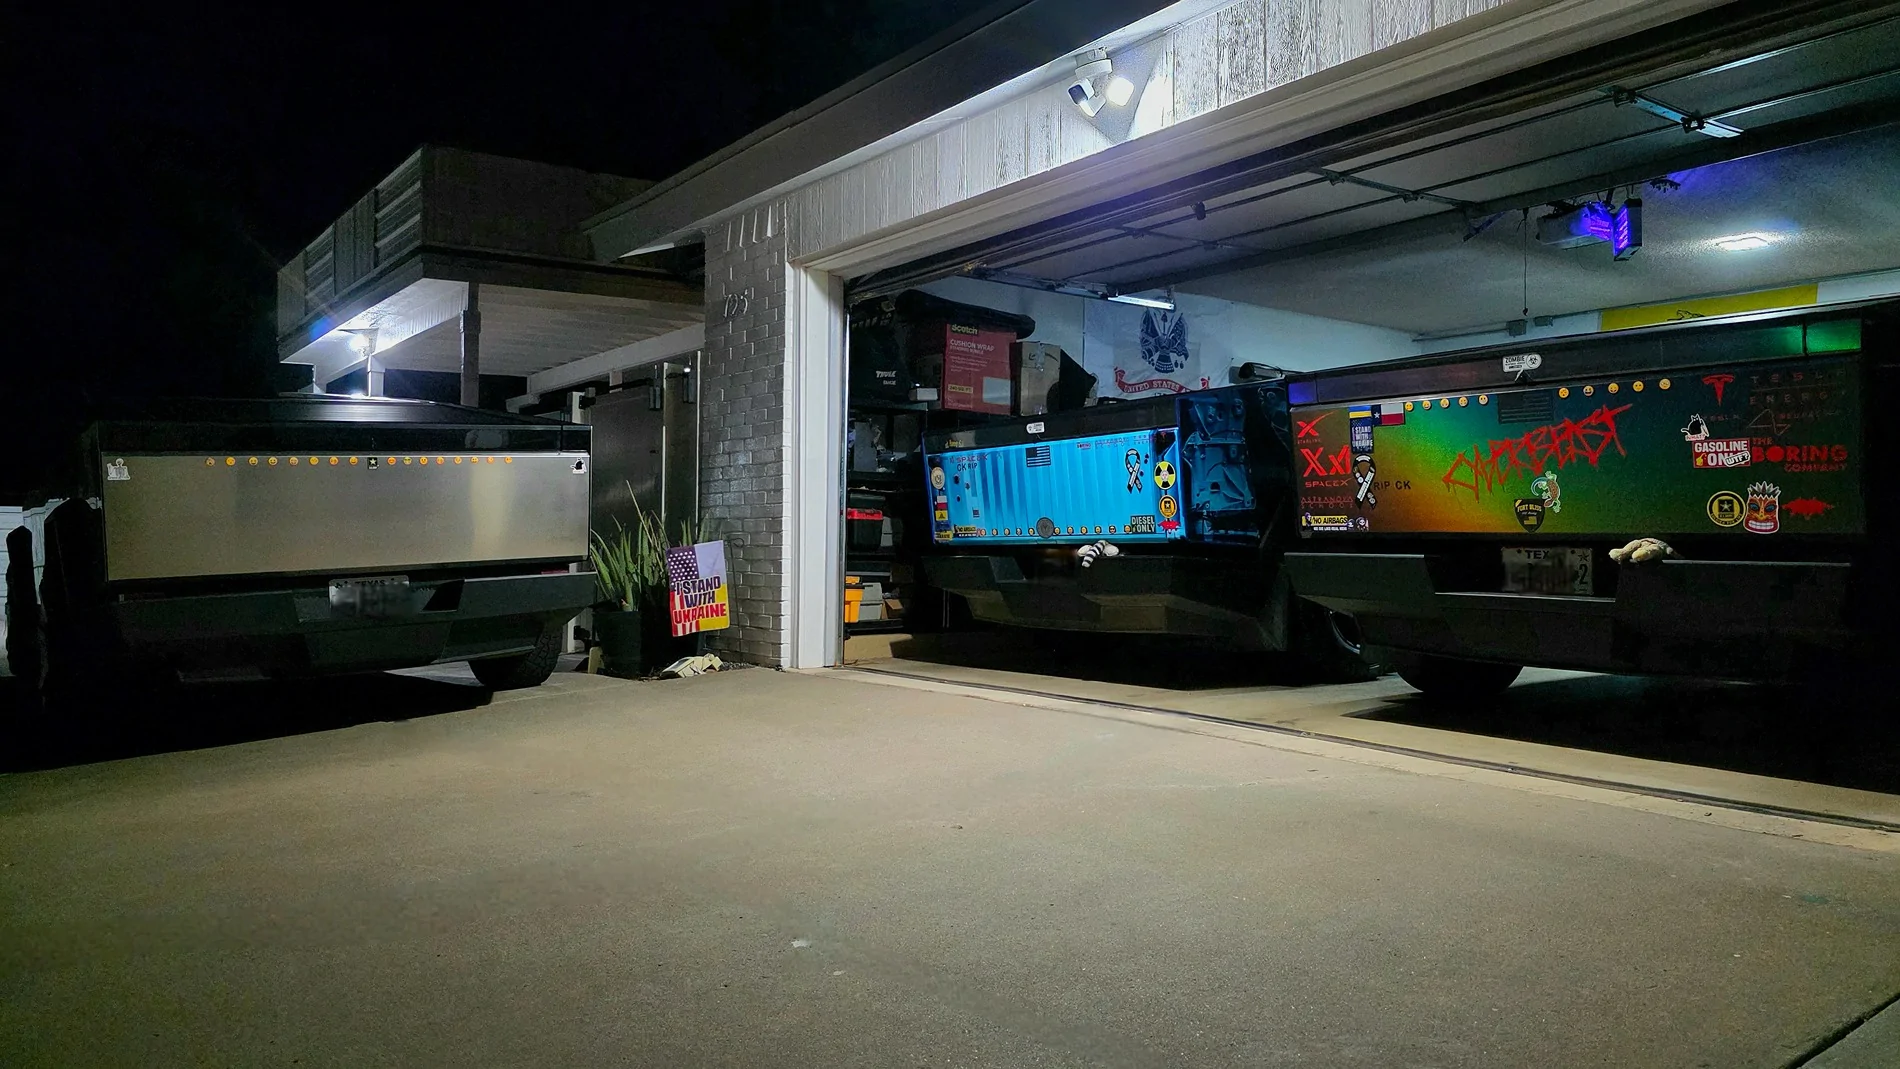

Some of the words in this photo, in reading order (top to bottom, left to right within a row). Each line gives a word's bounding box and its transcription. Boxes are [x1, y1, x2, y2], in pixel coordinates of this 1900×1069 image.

[951, 324, 978, 335] Scotch
[950, 339, 976, 350] CUSHION
[976, 343, 995, 353] WRAP
[1123, 382, 1150, 393] UNITED
[1152, 380, 1180, 392] STATES
[1694, 440, 1748, 453] GASOLINE
[1707, 452, 1746, 467] ON
[1752, 444, 1849, 463] BORING
[1374, 481, 1391, 491] RIP
[1395, 480, 1412, 490] CK
[1131, 516, 1156, 526] DIESEL
[1323, 516, 1348, 524] AIRBAGS
[1136, 524, 1157, 534] ONLY
[675, 581, 681, 596] I
[682, 576, 721, 595] STAND
[684, 590, 716, 608] WITH
[673, 603, 727, 624] UKRAINE
